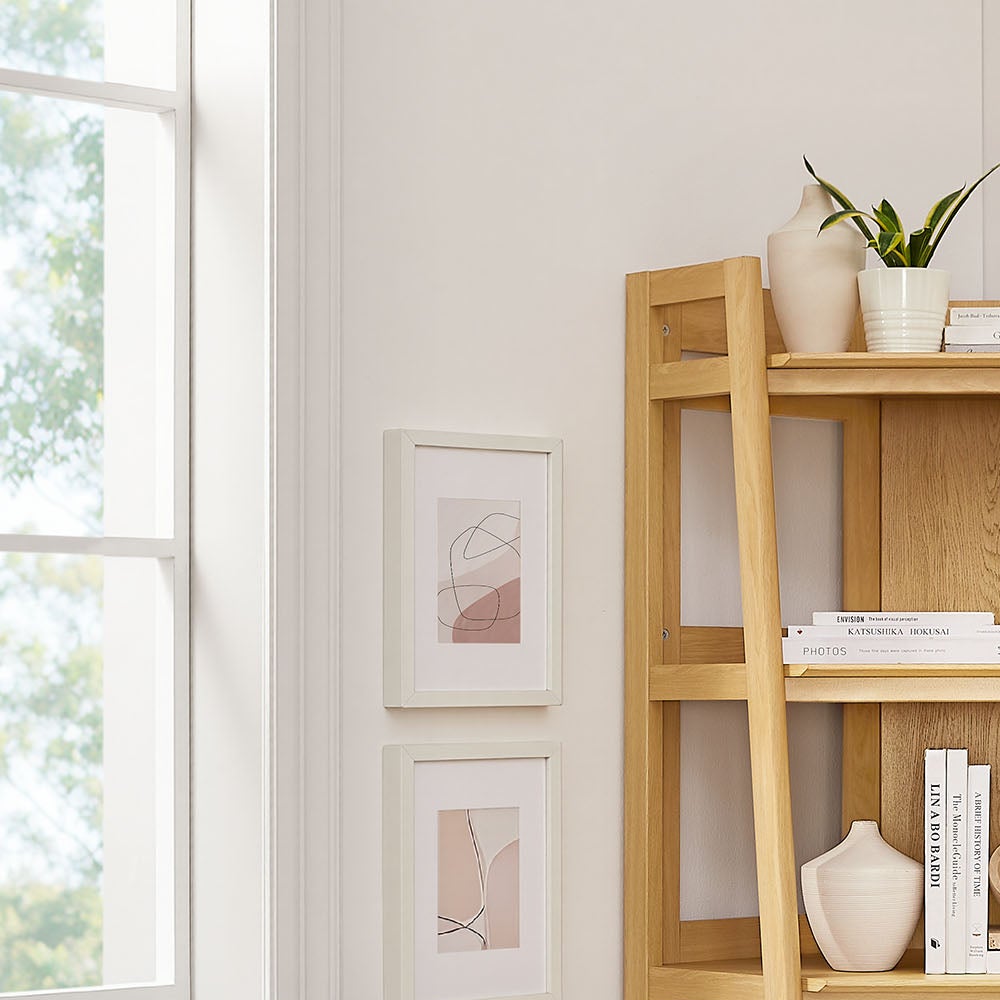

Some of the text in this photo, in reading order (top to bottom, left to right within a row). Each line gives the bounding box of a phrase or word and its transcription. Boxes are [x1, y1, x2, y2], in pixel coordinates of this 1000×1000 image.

[803, 647, 846, 656] PHOTOS
[953, 794, 961, 811] The
[931, 784, 940, 887] LIN A BO BARDI
[974, 863, 981, 874] OF
